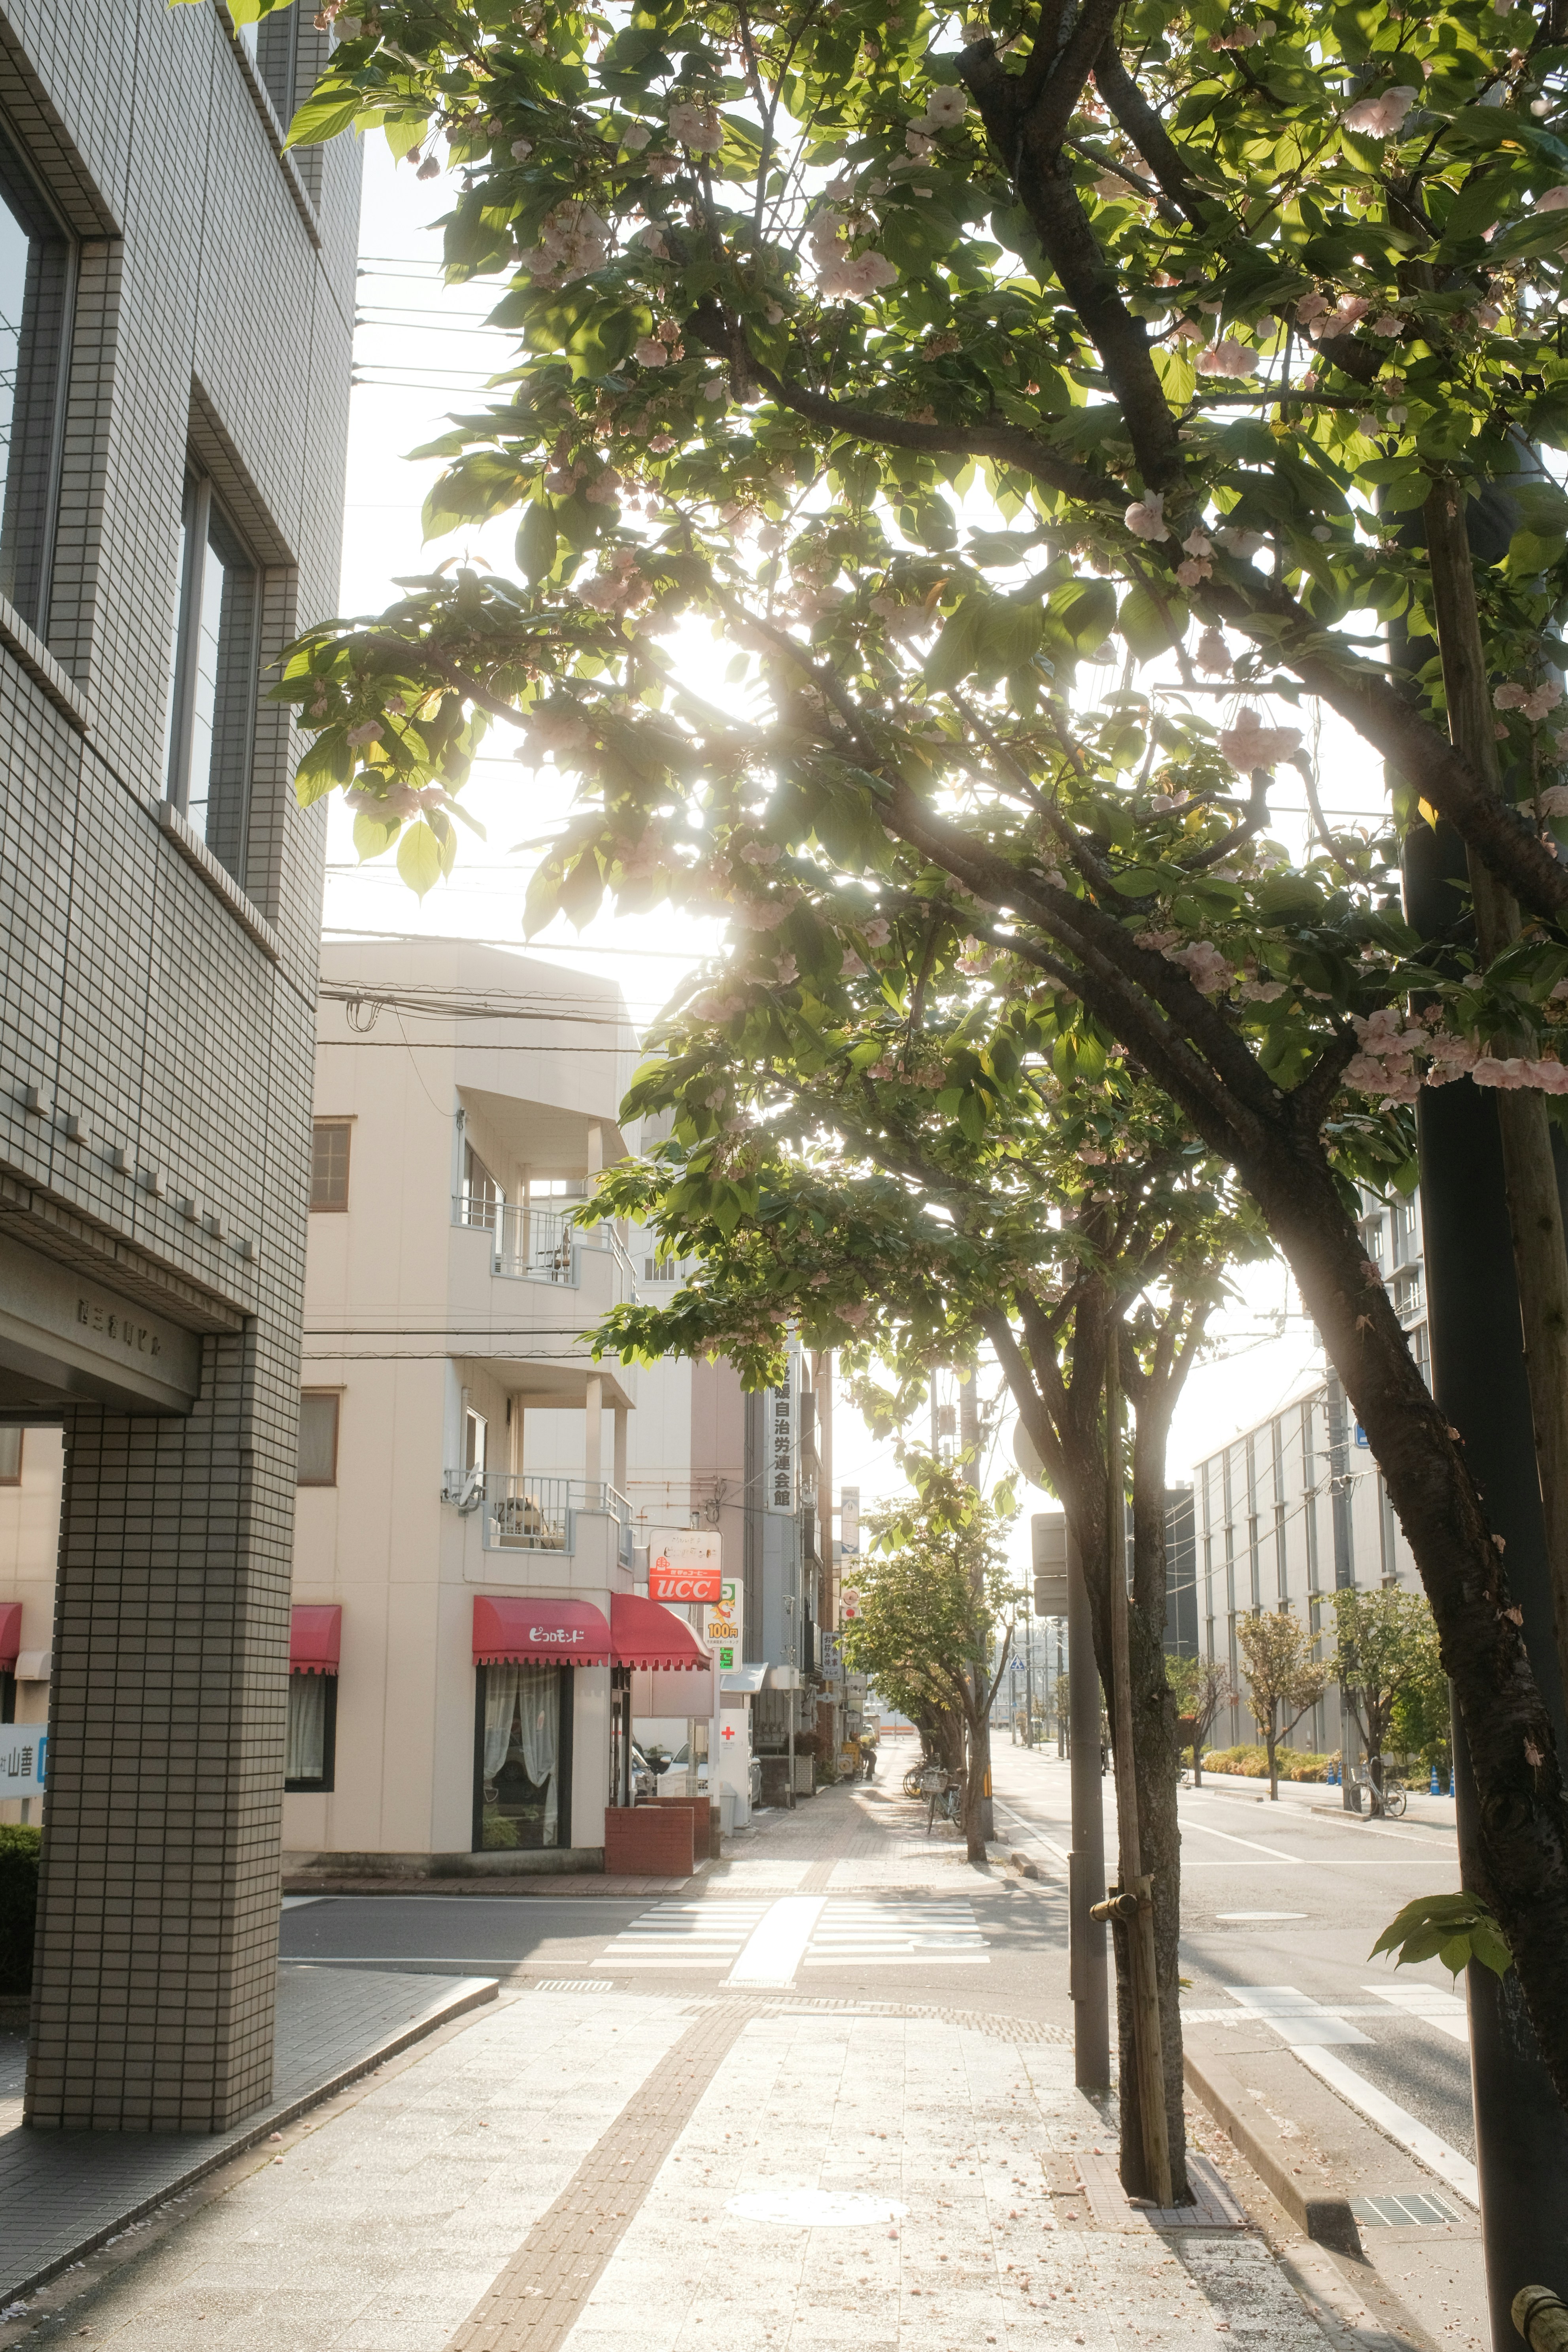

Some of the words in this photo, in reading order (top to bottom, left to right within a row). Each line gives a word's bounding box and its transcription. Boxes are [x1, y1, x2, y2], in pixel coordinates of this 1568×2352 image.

[529, 1627, 584, 1643] ピコロモンド
[708, 1623, 738, 1638] 100円
[8, 1746, 33, 1777] 山善
